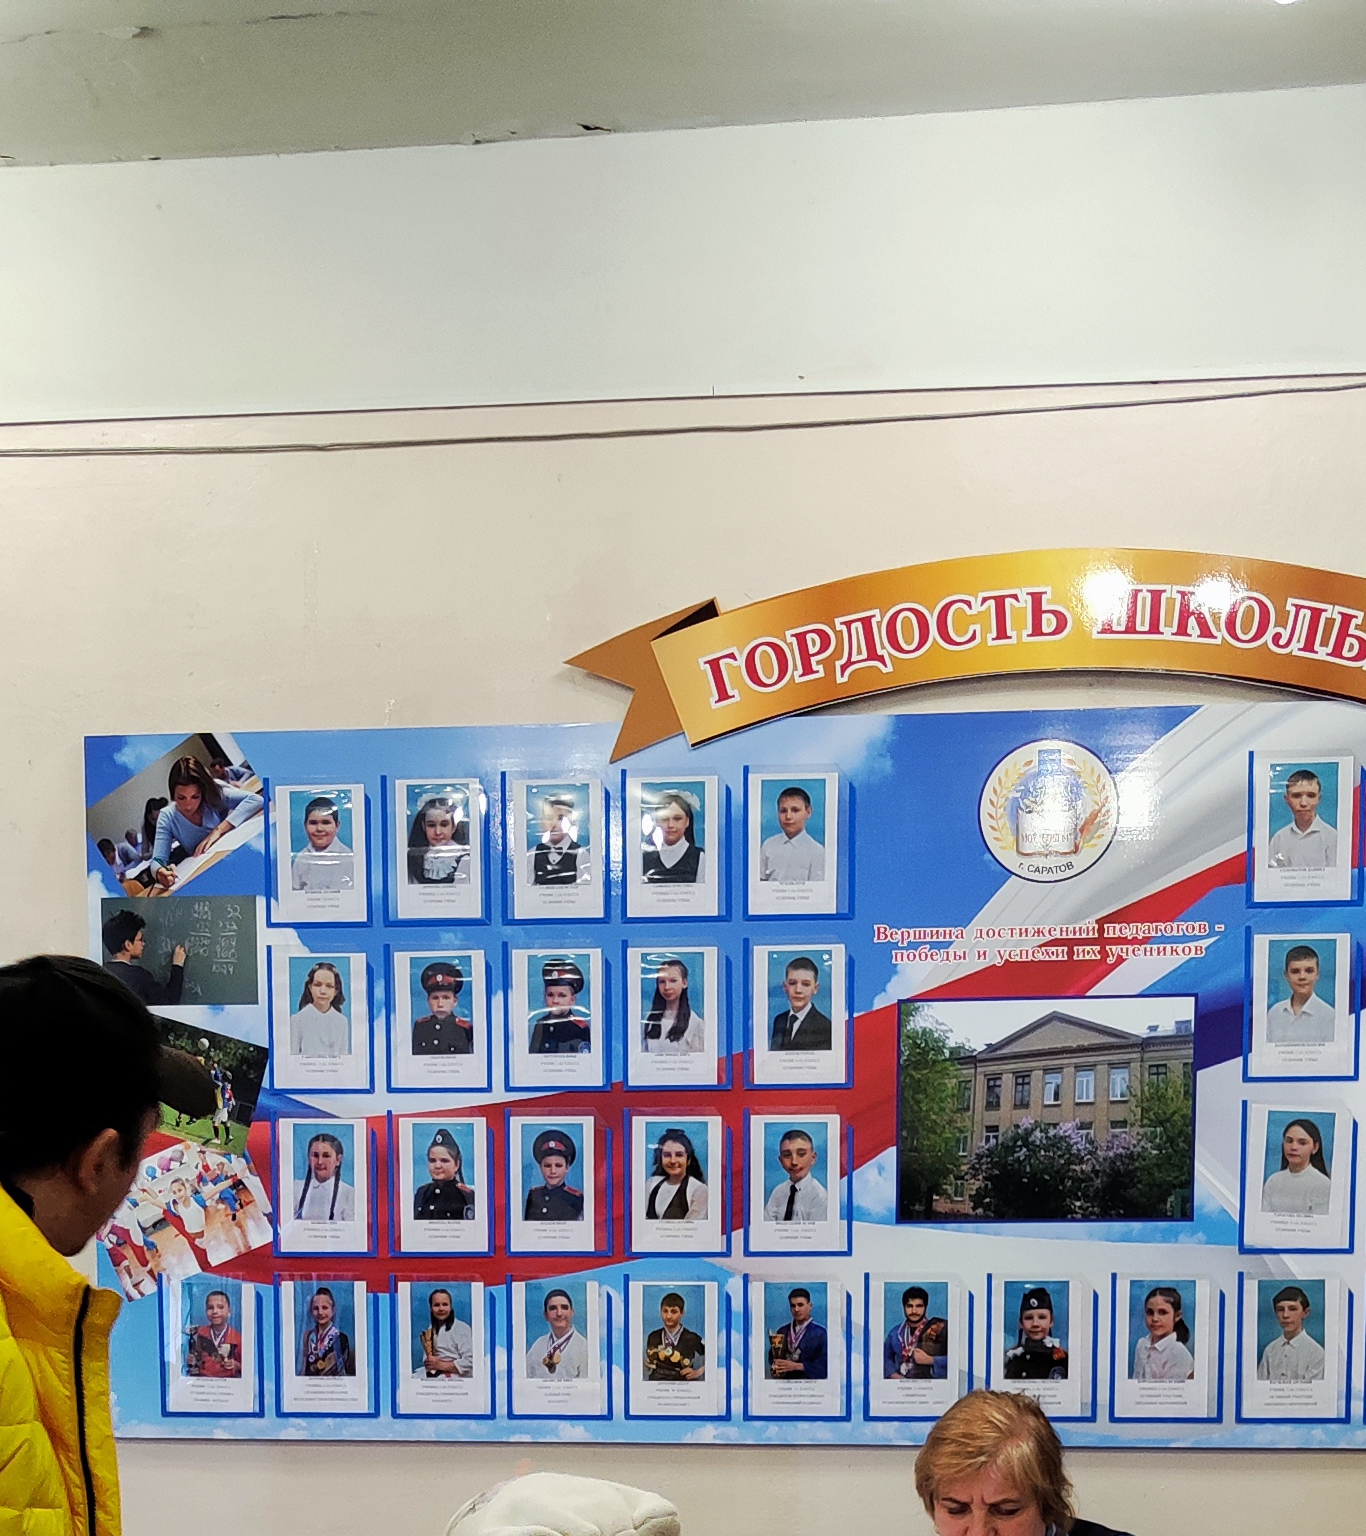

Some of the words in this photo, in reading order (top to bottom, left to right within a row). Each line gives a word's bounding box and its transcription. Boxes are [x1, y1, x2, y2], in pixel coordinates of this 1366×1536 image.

[701, 586, 1071, 708] ГОРДОСТЬ
[1027, 861, 1075, 875] САРАТОВ
[874, 925, 966, 946] Вершина
[973, 919, 1098, 941] достижений
[1103, 921, 1209, 938] педагогов
[892, 944, 967, 964] победы
[975, 949, 986, 961] и
[997, 947, 1068, 966] успехи
[1074, 947, 1099, 961] их
[1107, 943, 1205, 964] учеников
